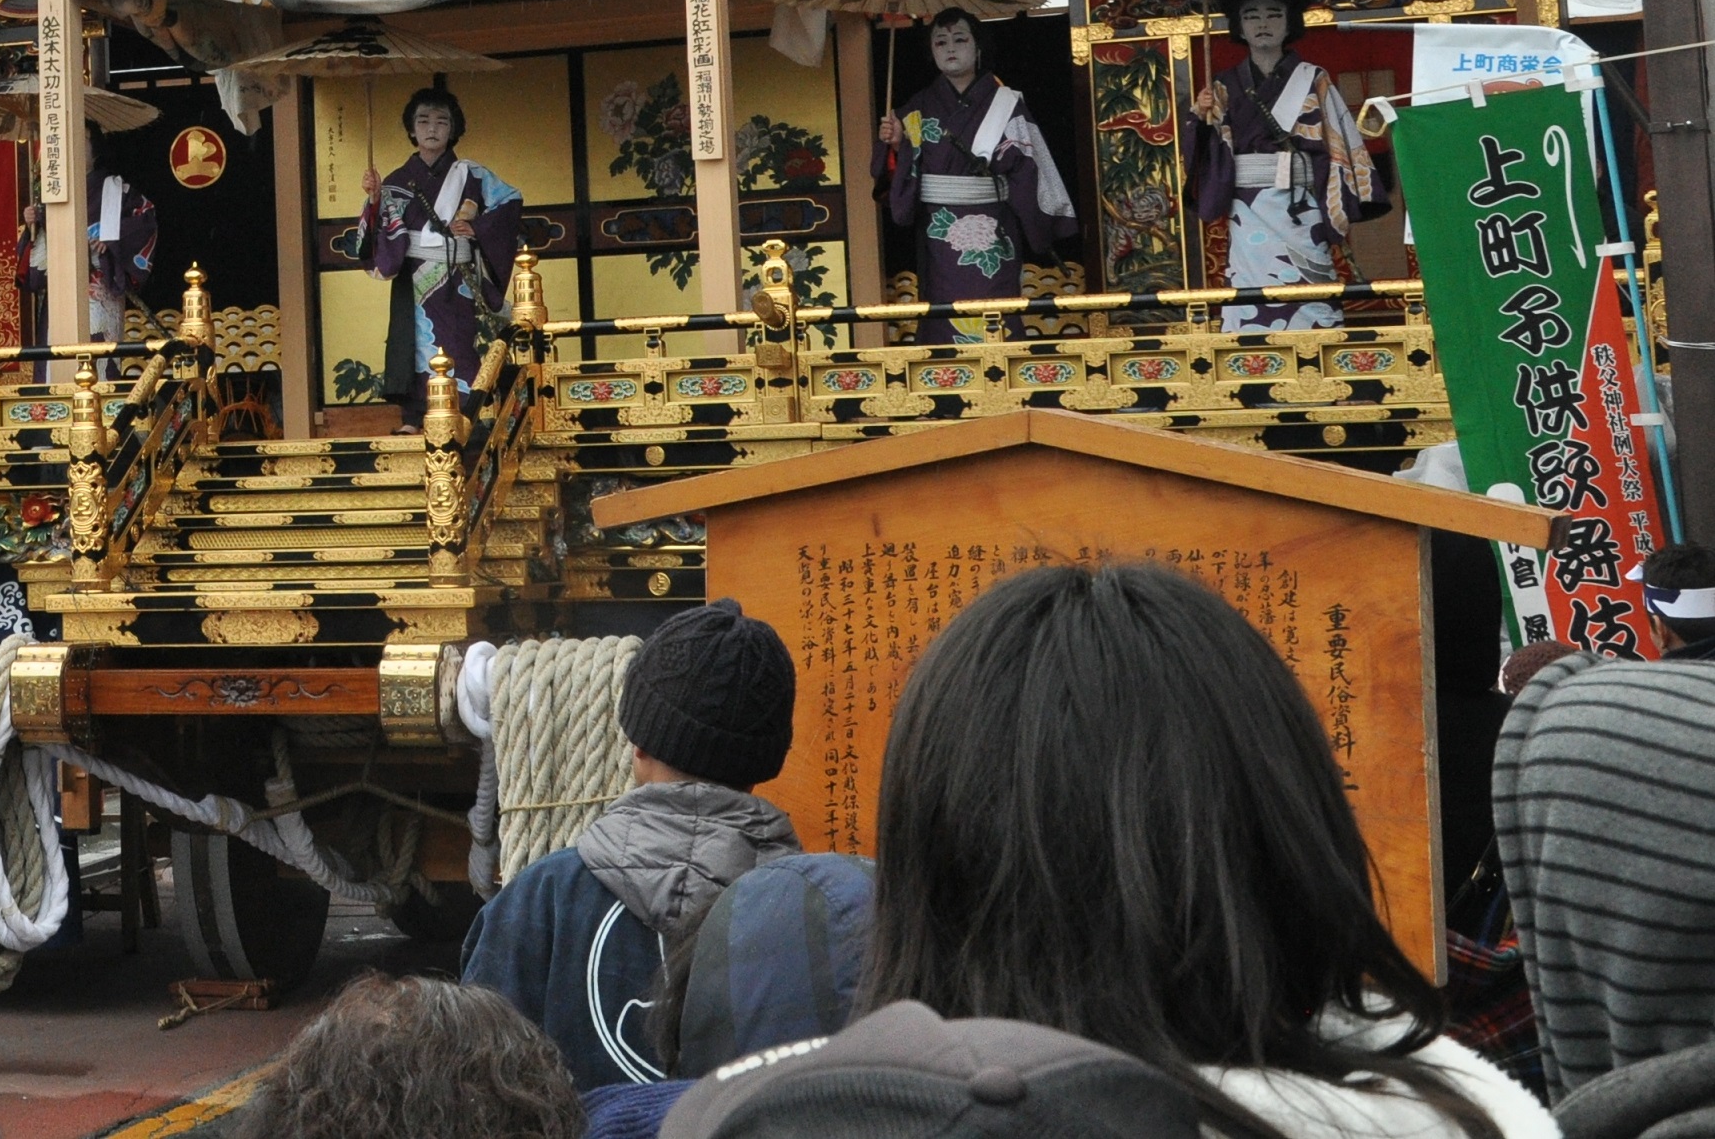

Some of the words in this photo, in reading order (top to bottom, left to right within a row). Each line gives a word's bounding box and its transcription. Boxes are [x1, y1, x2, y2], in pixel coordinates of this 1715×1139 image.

[1452, 53, 1563, 74] 上町商栄会
[1468, 135, 1646, 662] 上町子供歌舞伎
[1590, 344, 1644, 502] 秩父神社例大祭
[1322, 603, 1358, 761] 重要民俗資料
